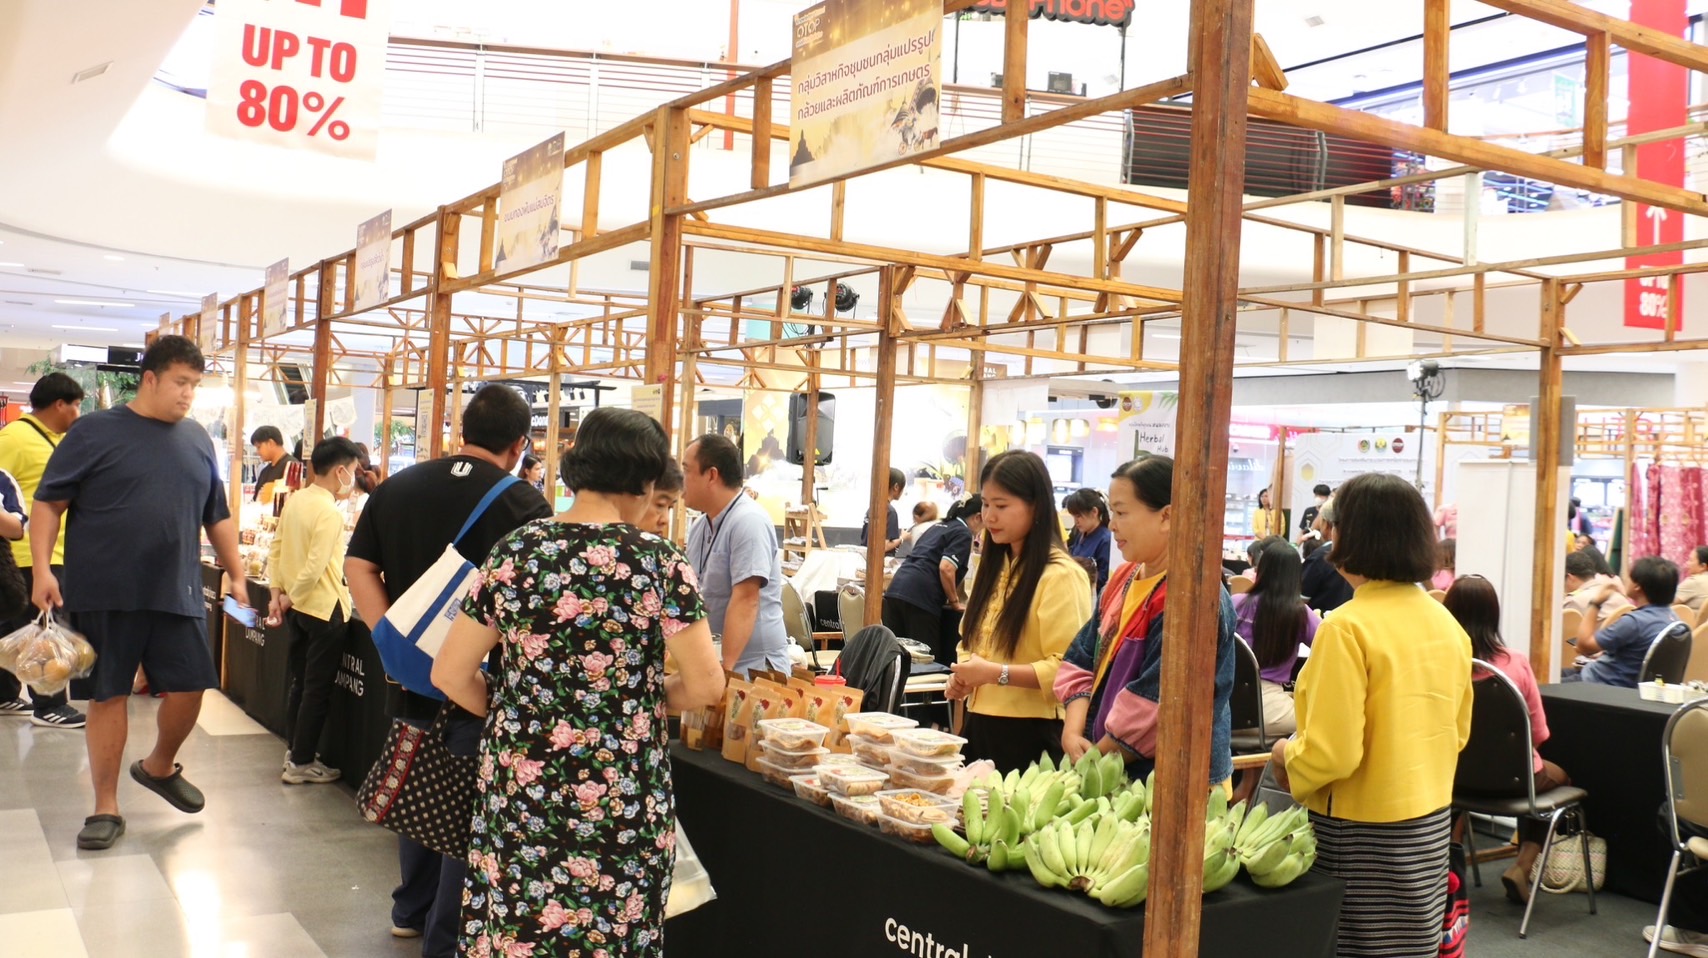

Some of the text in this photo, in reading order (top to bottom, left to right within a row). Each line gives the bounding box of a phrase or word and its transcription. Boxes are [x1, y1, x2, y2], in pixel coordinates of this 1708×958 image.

[242, 23, 357, 83] UP TO
[798, 30, 933, 95] กลุ่มวิสาหกิจชุมชนกลุ่มแปรรูป
[237, 79, 350, 141] 80%
[797, 63, 931, 120] กล้วยและผลิตภัณฑ์การเกษตร
[1140, 432, 1165, 443] Herbal
